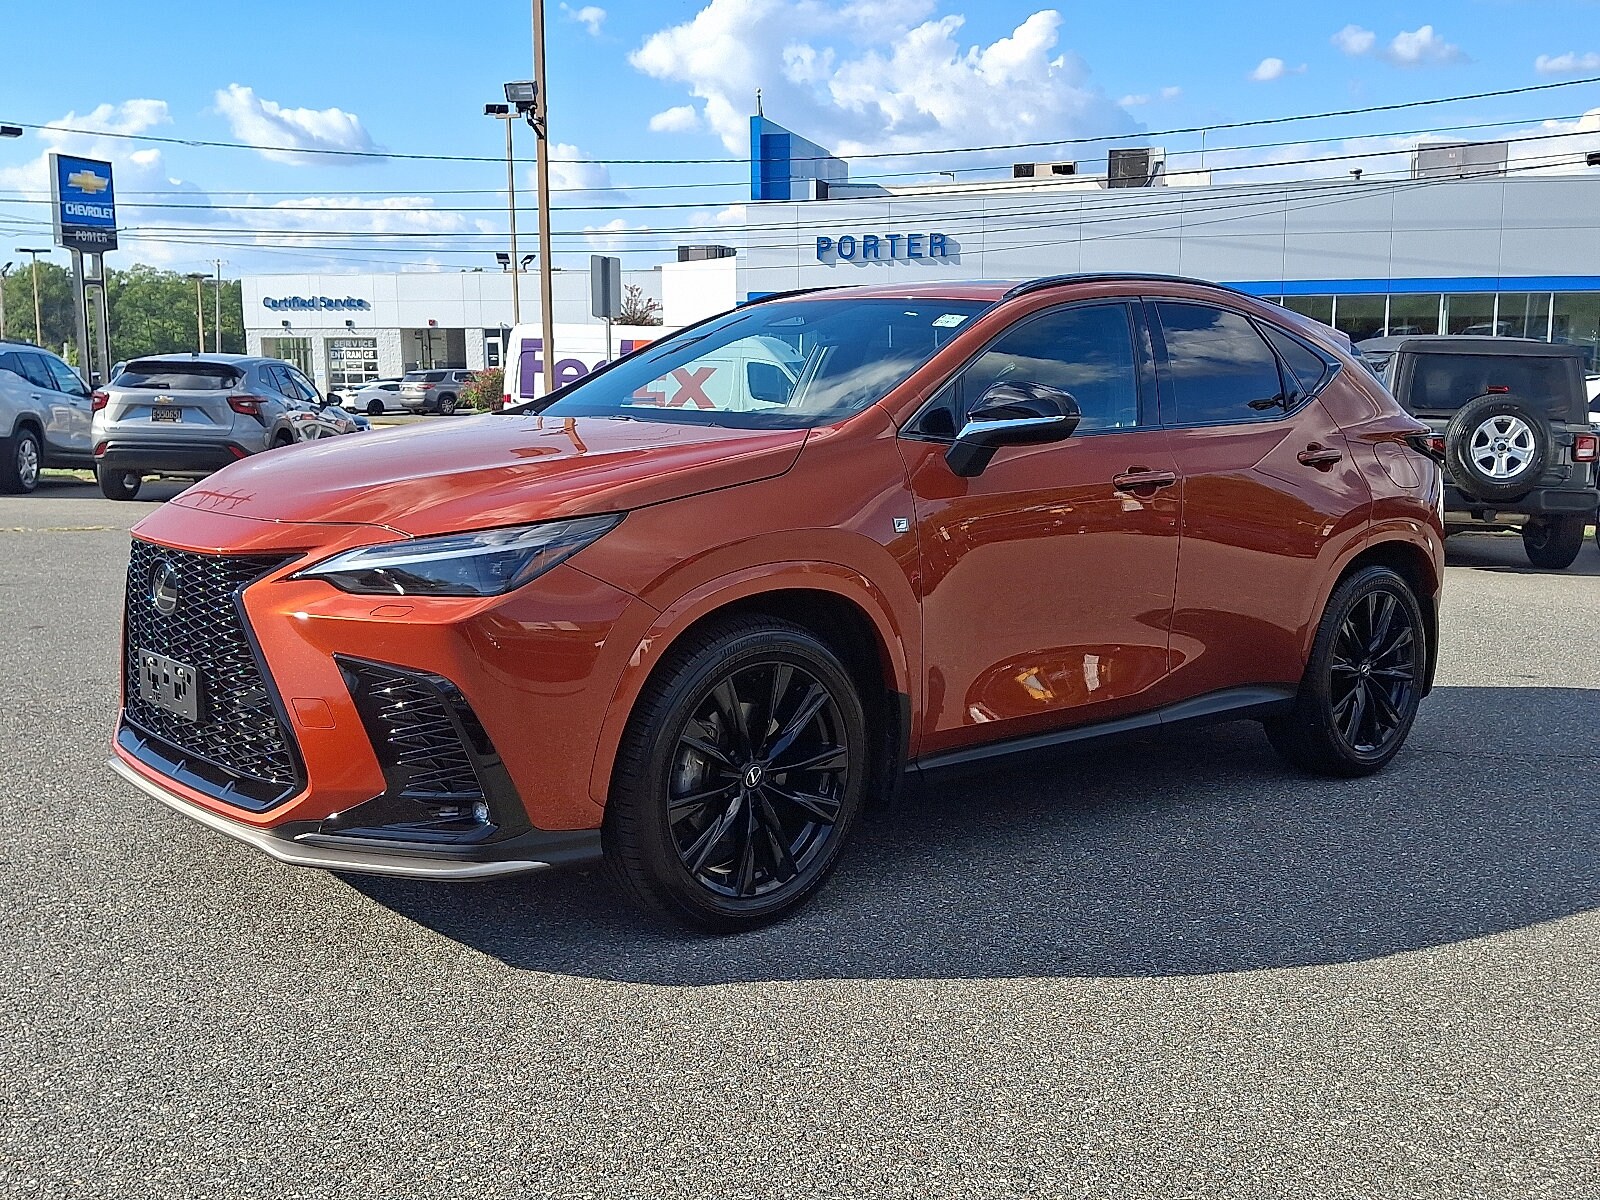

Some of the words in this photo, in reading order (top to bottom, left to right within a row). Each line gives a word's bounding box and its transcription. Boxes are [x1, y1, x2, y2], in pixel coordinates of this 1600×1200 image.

[65, 203, 113, 219] CHEVROLET
[75, 230, 107, 243] PORTER
[816, 233, 946, 260] PORTER
[263, 295, 315, 308] Certified
[319, 295, 364, 308] Service
[334, 340, 374, 348] SERVICE
[330, 349, 374, 359] ENTRANCE
